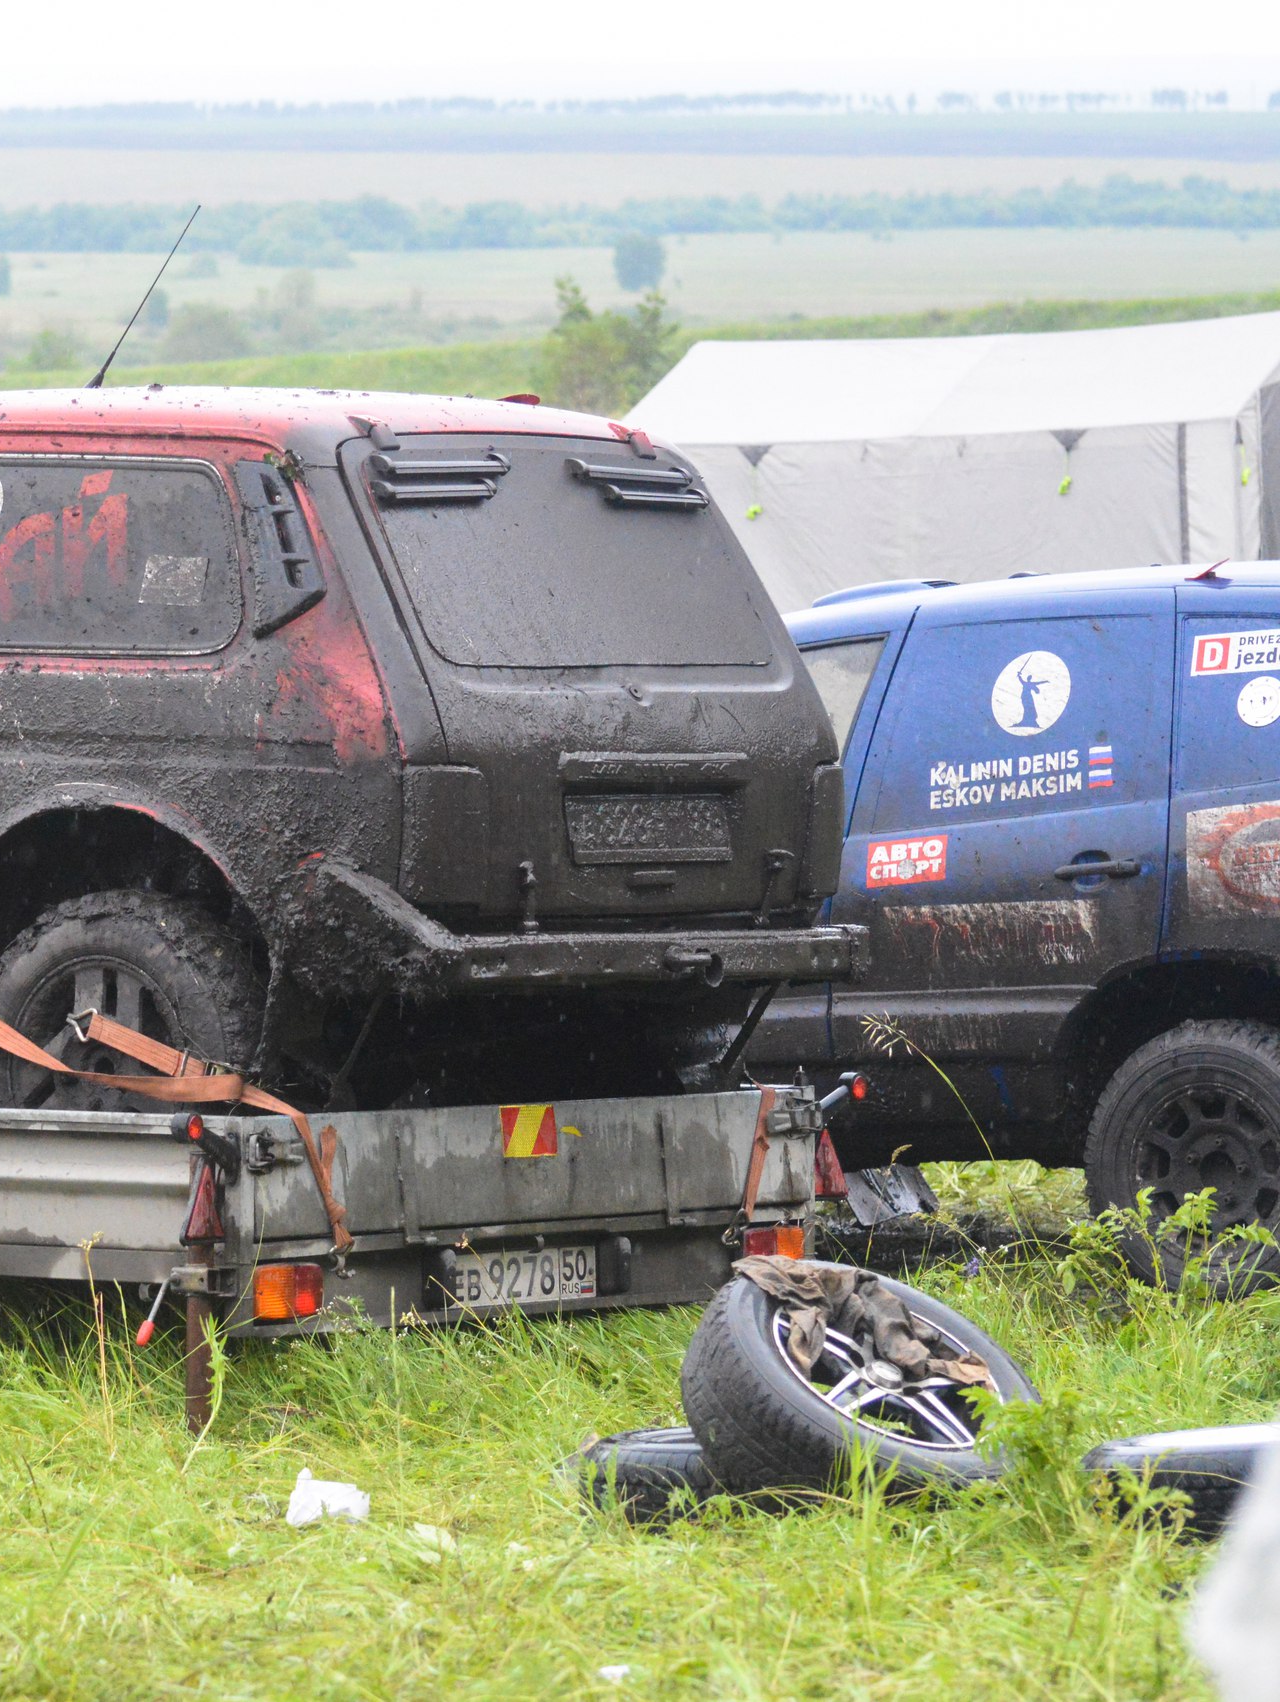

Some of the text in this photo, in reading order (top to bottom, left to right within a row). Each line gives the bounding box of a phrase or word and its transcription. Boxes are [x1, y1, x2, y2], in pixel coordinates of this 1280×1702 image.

[930, 749, 1079, 787] KALININ DENIS
[929, 772, 1082, 810] ESKOV MAKSIM
[870, 839, 944, 864] АВТО
[488, 1255, 555, 1299] 9278
[562, 1250, 587, 1282] 50
[561, 1282, 580, 1294] RUS
